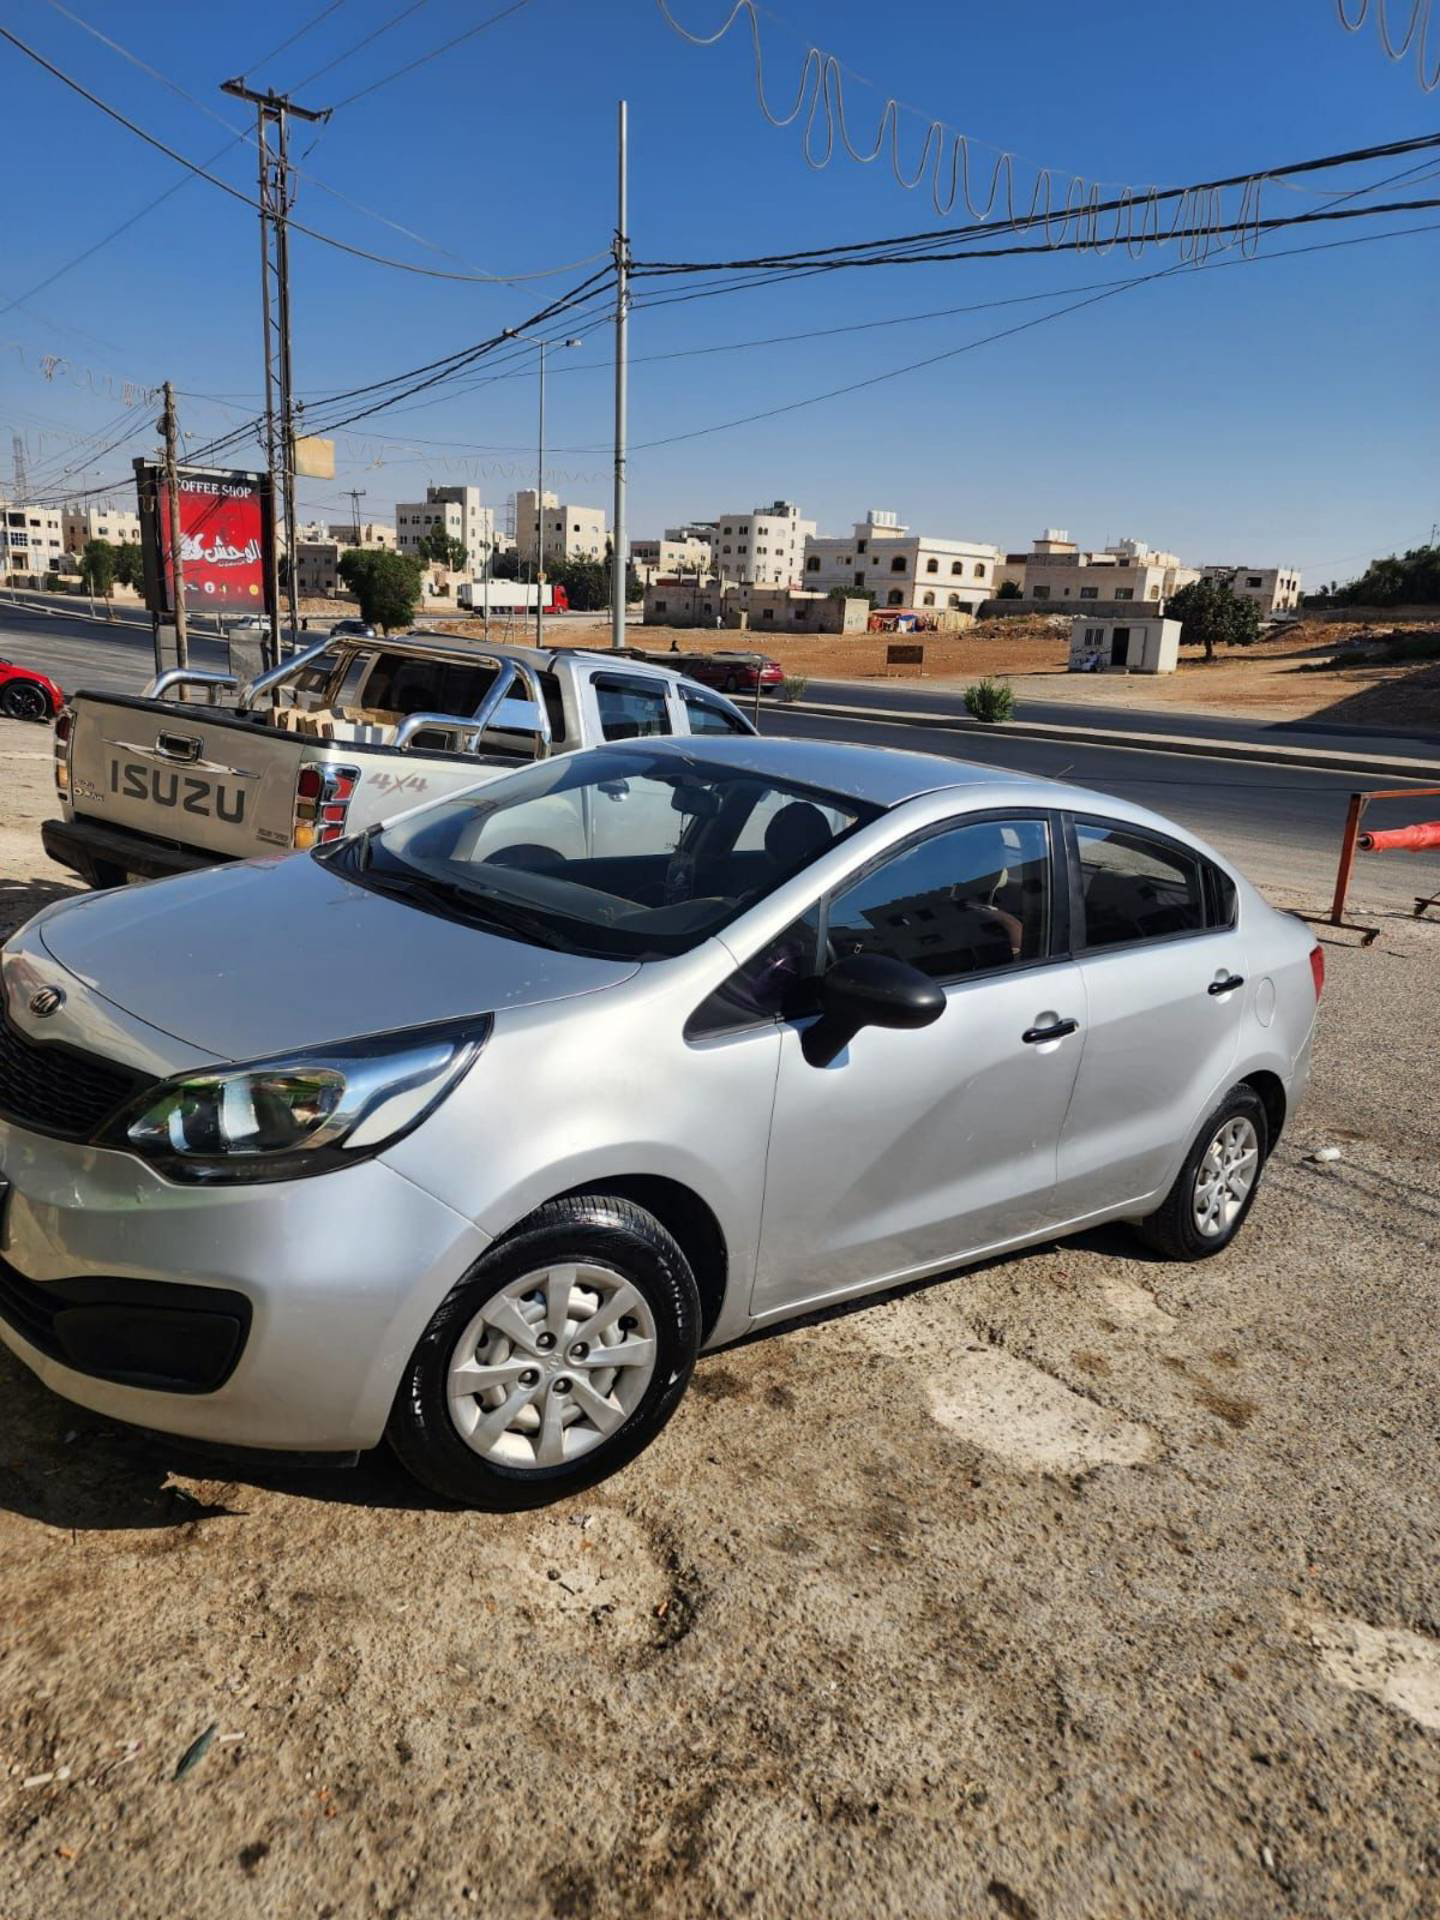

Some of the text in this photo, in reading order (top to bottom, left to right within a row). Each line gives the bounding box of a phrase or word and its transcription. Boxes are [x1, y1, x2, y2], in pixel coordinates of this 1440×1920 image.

[221, 484, 252, 498] SHOP
[205, 535, 261, 564] الوحش
[111, 760, 245, 823] ISUZU
